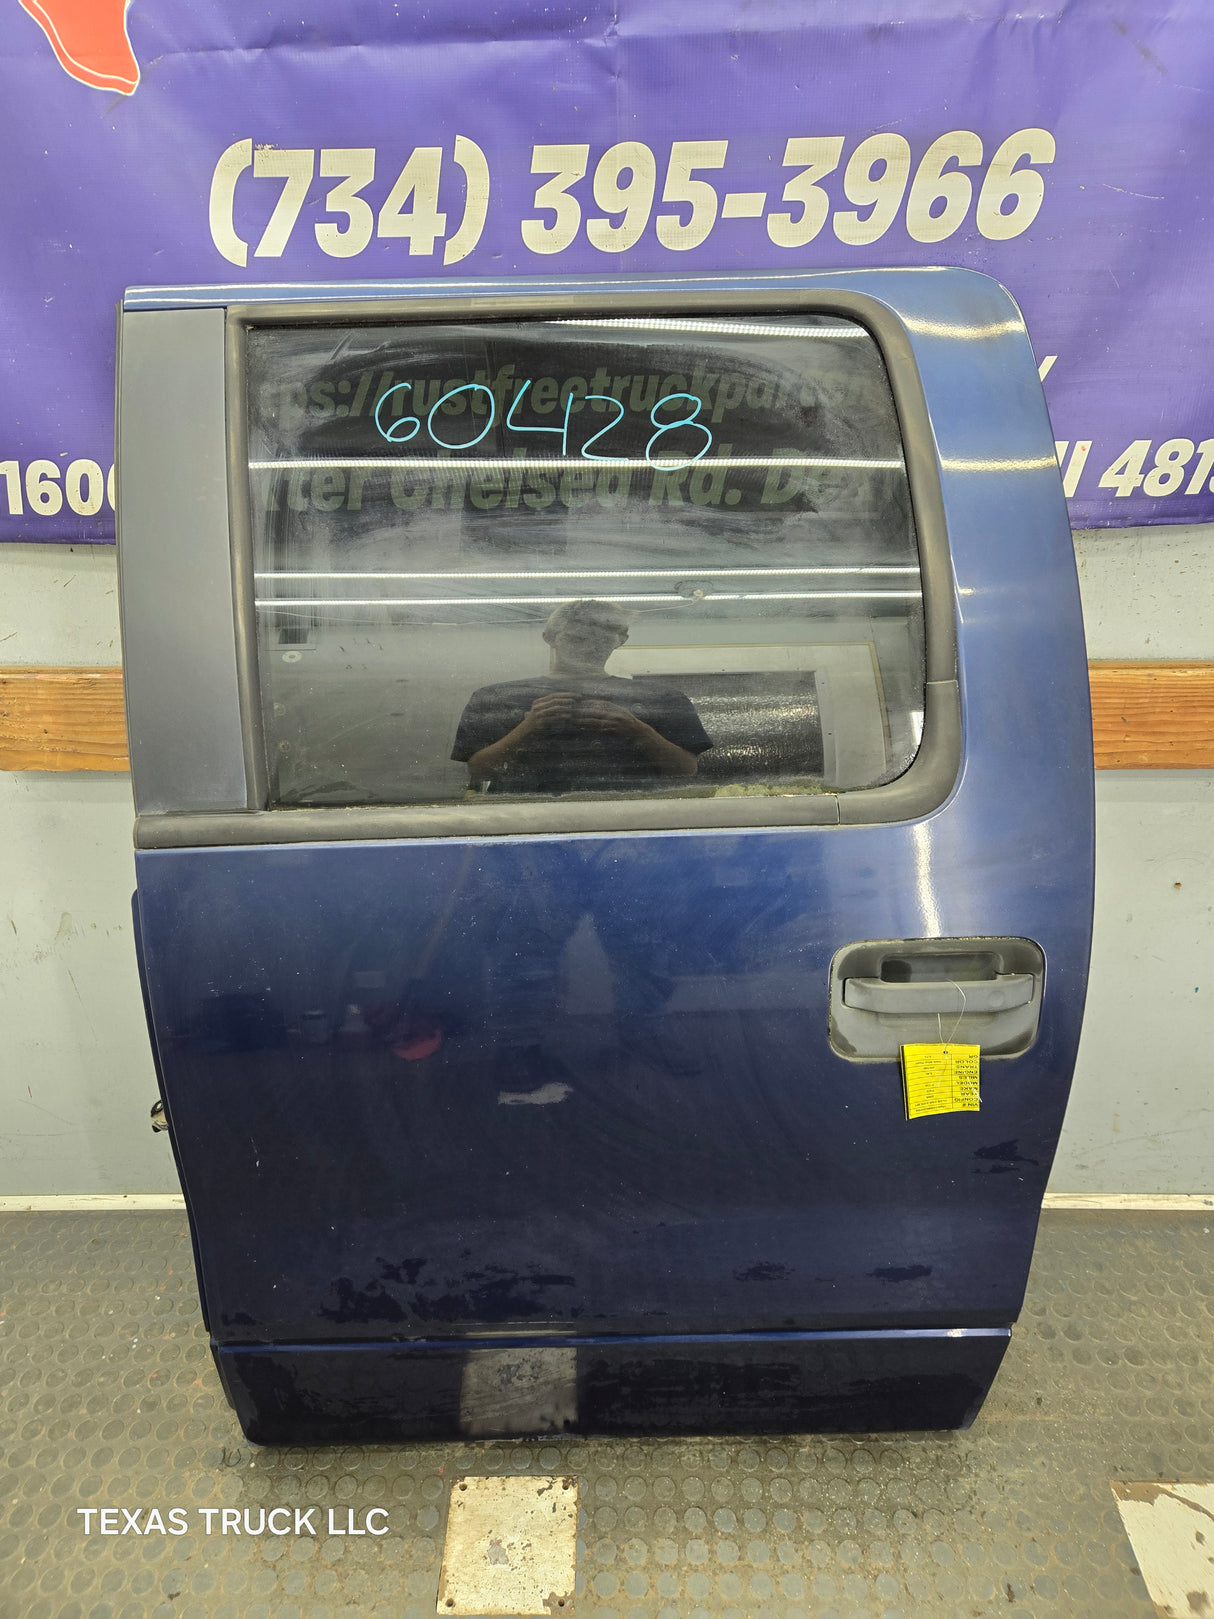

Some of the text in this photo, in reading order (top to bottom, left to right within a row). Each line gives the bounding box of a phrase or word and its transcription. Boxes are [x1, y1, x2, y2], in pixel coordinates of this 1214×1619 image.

[209, 128, 1057, 267] (734) 395-3966
[374, 379, 714, 471] 60428
[0, 458, 116, 516] 160
[389, 447, 634, 512] Chelsea
[1098, 438, 1214, 497] 481
